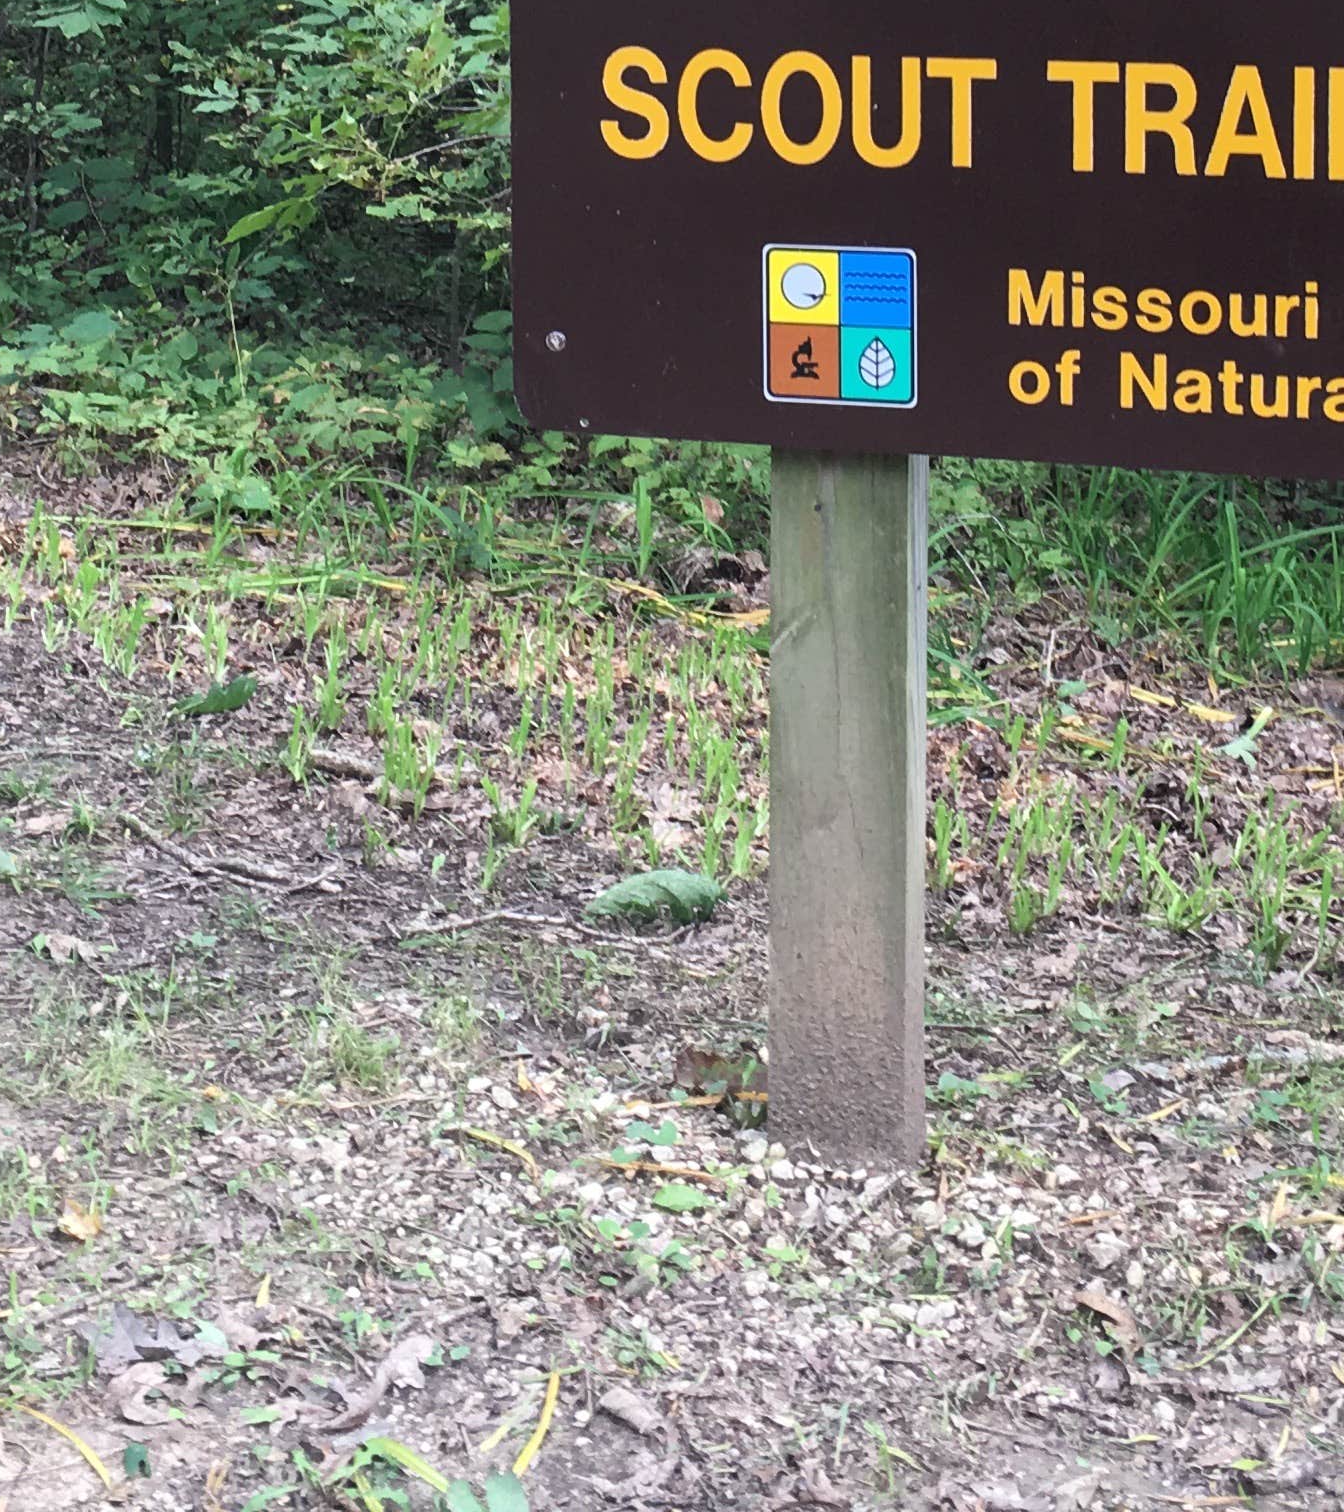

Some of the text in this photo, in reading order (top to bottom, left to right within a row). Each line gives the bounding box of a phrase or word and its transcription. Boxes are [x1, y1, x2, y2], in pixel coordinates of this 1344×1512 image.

[599, 44, 998, 169] SCOUT
[1007, 268, 1320, 340] Missouri
[1007, 348, 1082, 406] of
